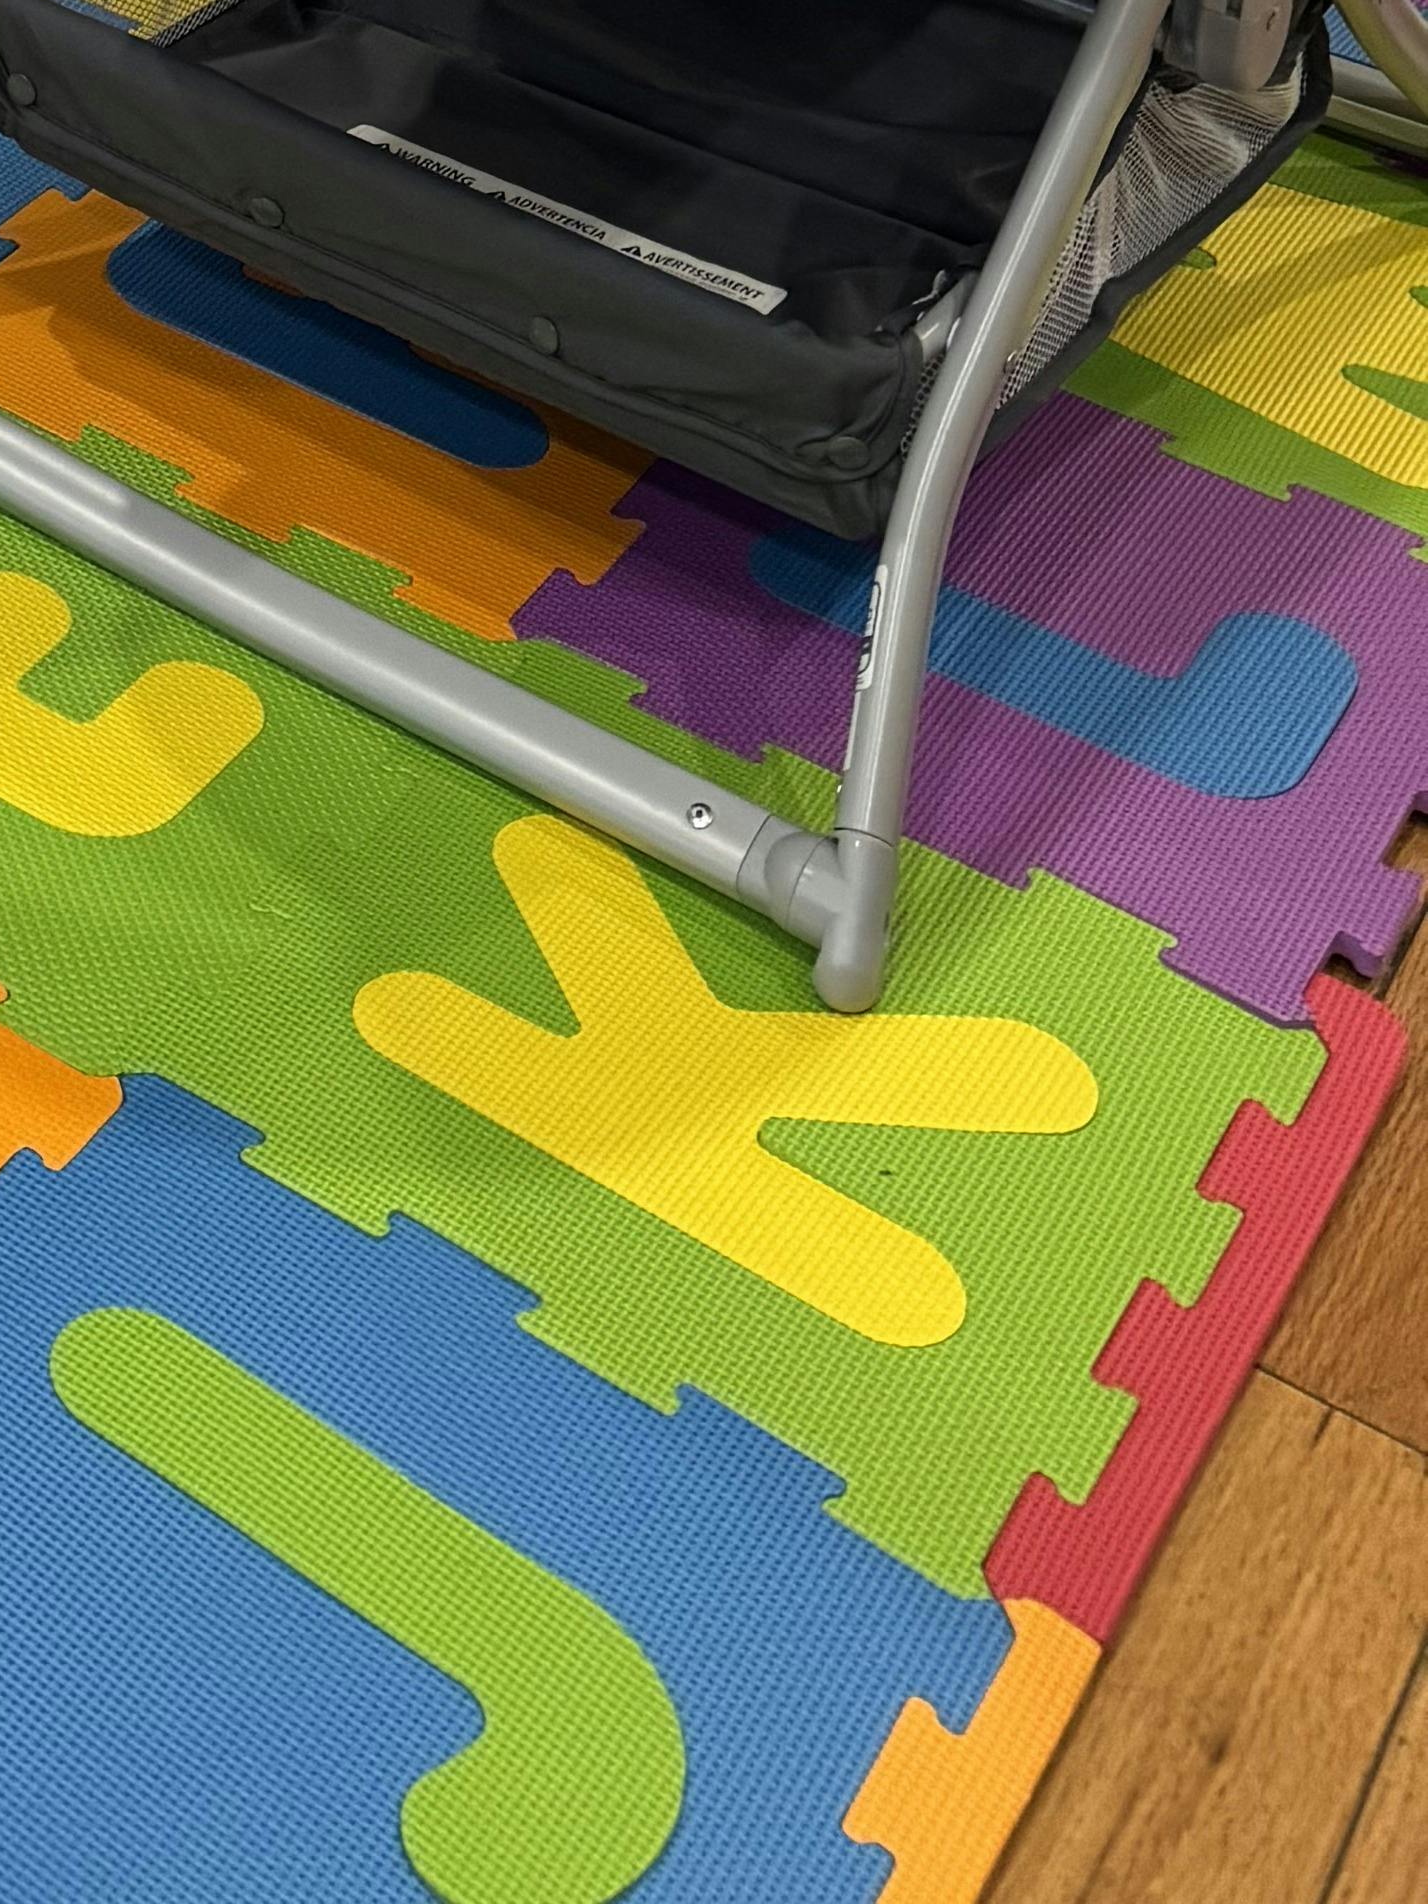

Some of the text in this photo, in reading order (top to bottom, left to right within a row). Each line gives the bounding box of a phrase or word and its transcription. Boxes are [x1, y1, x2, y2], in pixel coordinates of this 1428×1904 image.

[396, 148, 764, 300] WARNING ADVERTENCIA AVERTISSEMENT
[353, 815, 1098, 1346] K
[50, 1306, 685, 1904] J
